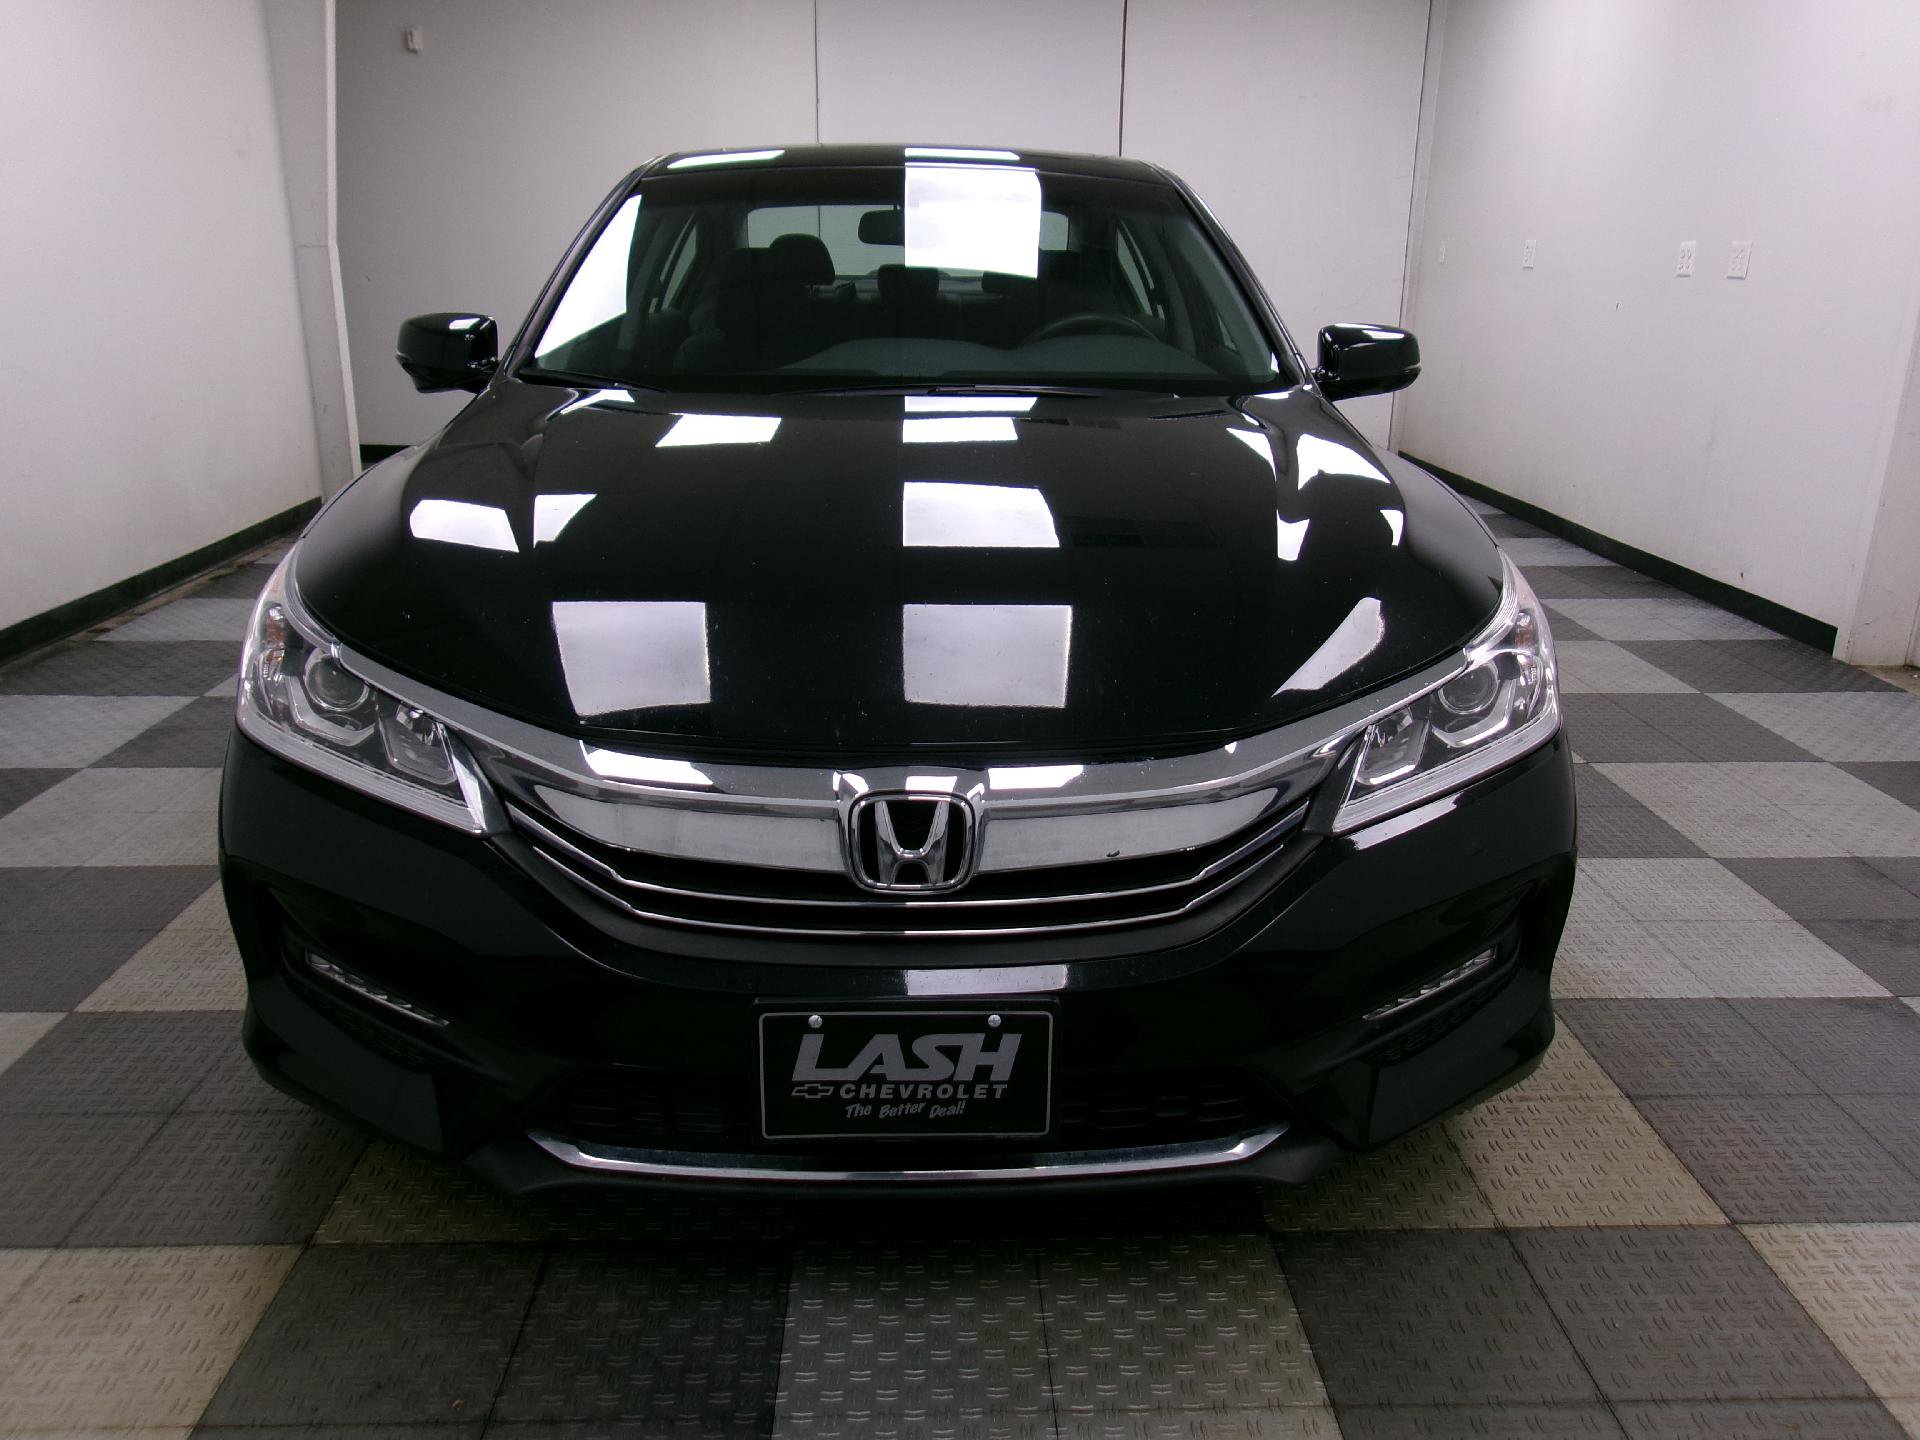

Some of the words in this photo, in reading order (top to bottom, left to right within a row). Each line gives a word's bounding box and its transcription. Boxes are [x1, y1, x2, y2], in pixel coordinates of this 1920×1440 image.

[792, 1033, 1022, 1082] LASH
[839, 1083, 1007, 1099] CHEVROLET
[846, 1103, 872, 1118] The
[879, 1102, 926, 1118] Better
